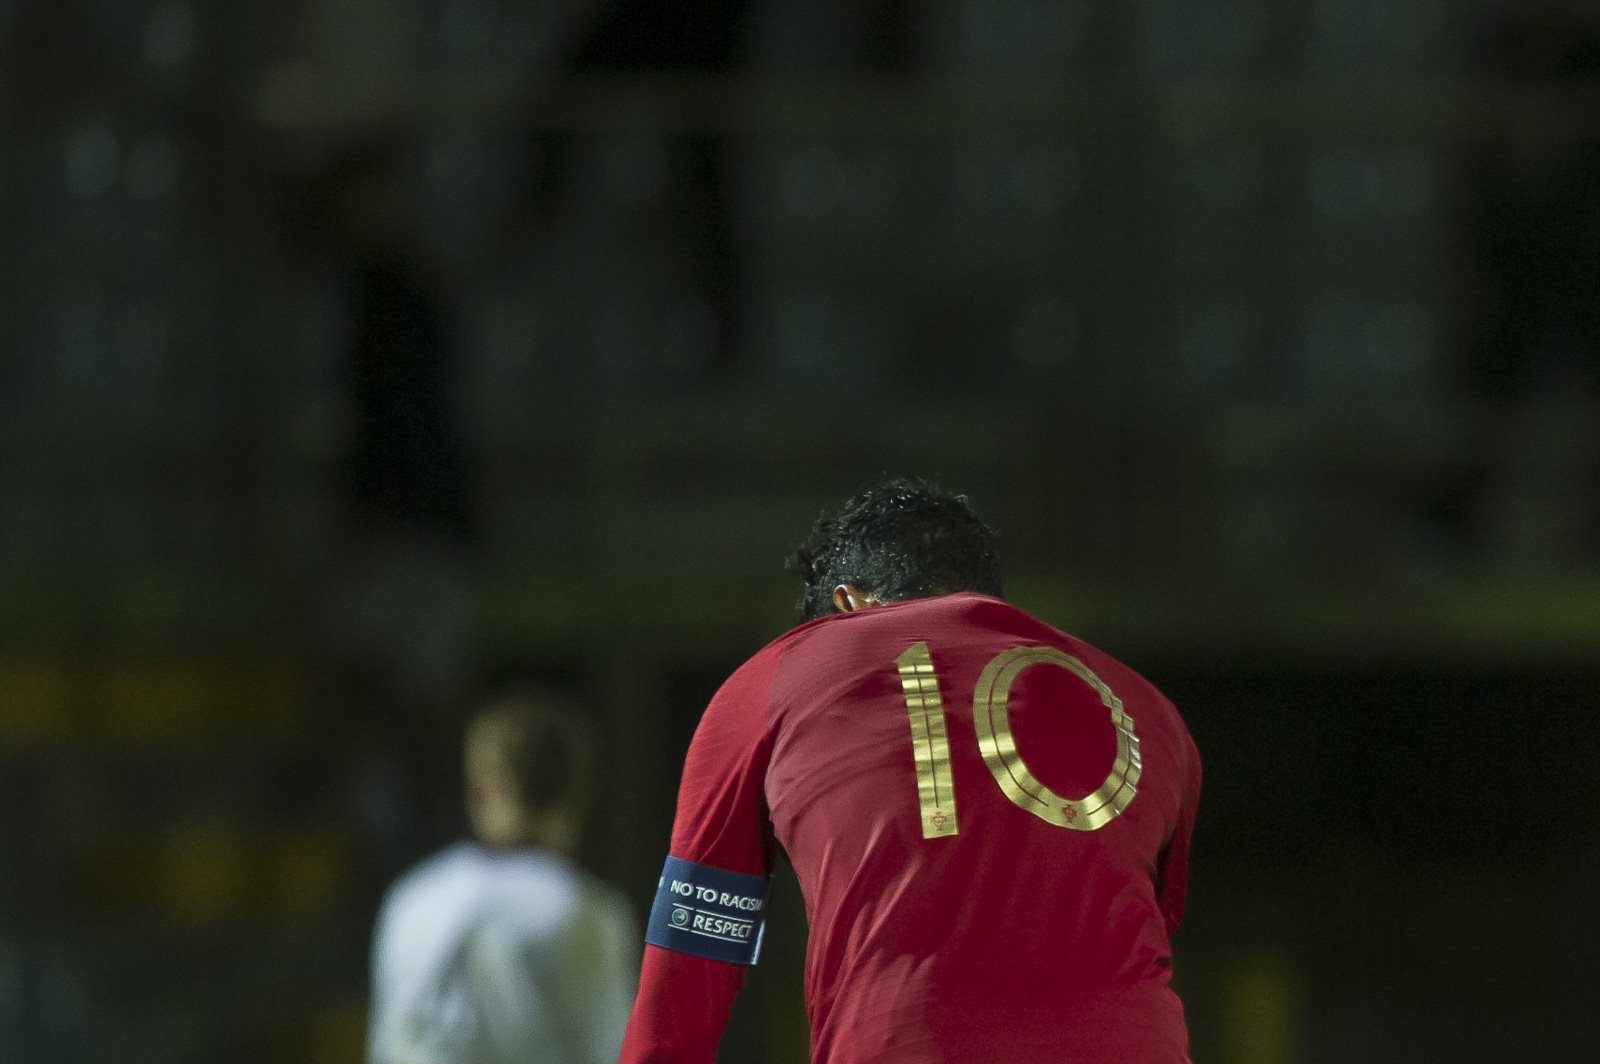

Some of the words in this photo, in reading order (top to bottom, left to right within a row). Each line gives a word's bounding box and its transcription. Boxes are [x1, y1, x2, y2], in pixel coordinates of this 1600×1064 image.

[893, 641, 1142, 839] 10
[670, 880, 693, 896] NO
[696, 886, 718, 902] TO
[693, 915, 753, 938] RESPECT
